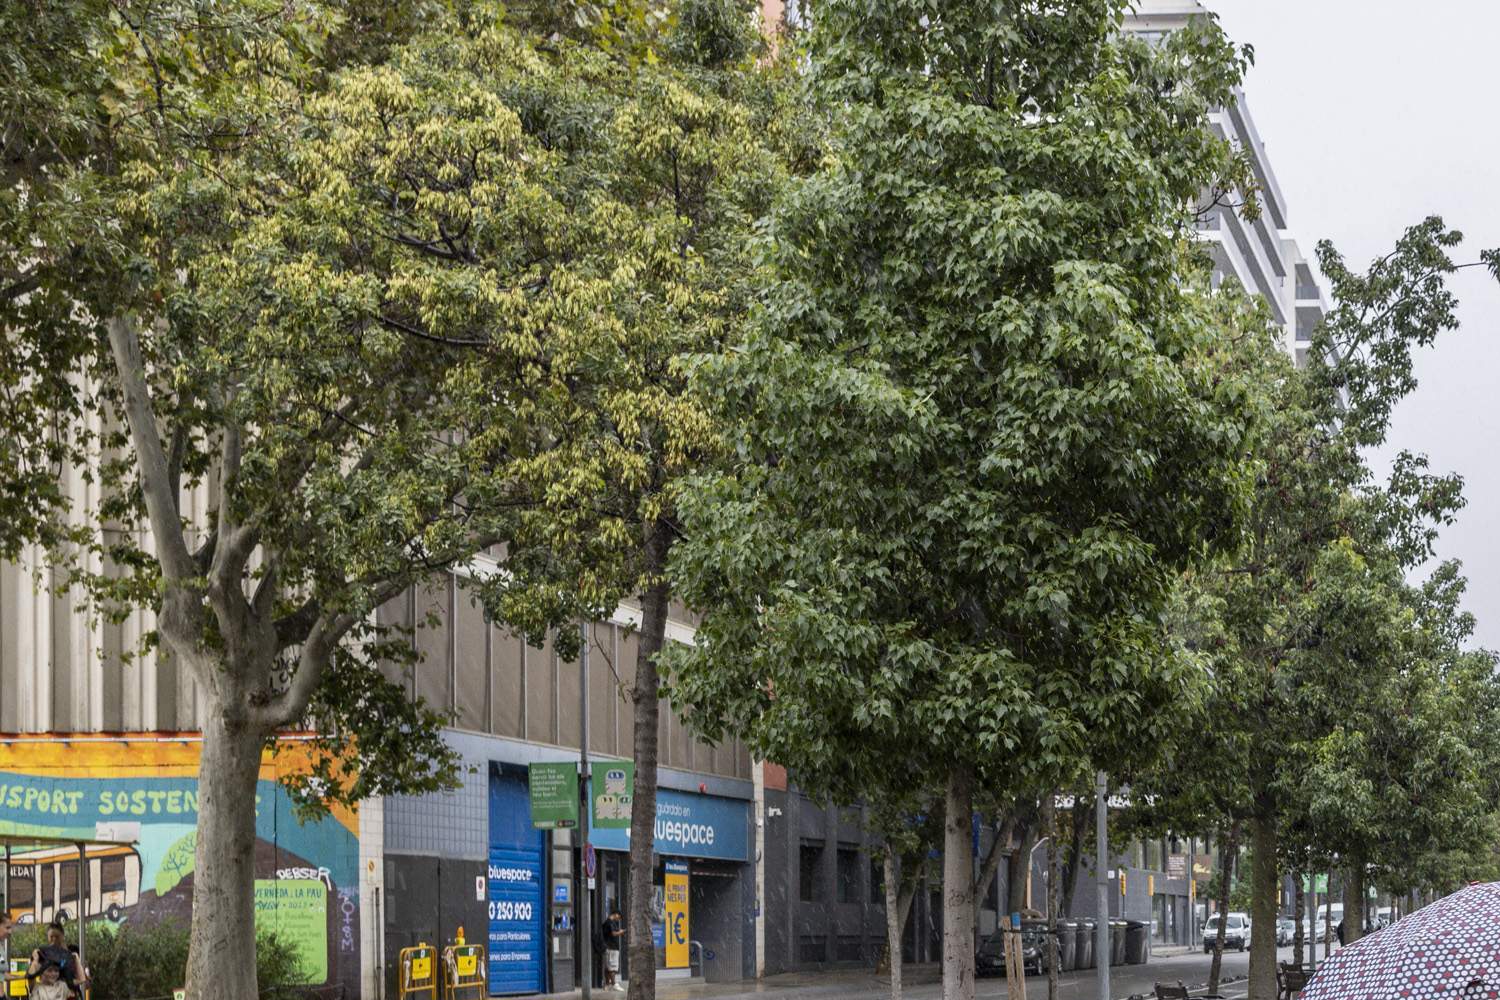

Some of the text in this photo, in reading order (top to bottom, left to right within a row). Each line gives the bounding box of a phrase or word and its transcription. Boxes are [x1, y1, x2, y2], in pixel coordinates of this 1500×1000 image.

[98, 789, 261, 815] SOSTEN
[653, 818, 715, 848] luespace
[488, 864, 532, 883] bluespace
[496, 902, 513, 920] 250
[514, 902, 532, 920] 900
[668, 911, 686, 945] 1€
